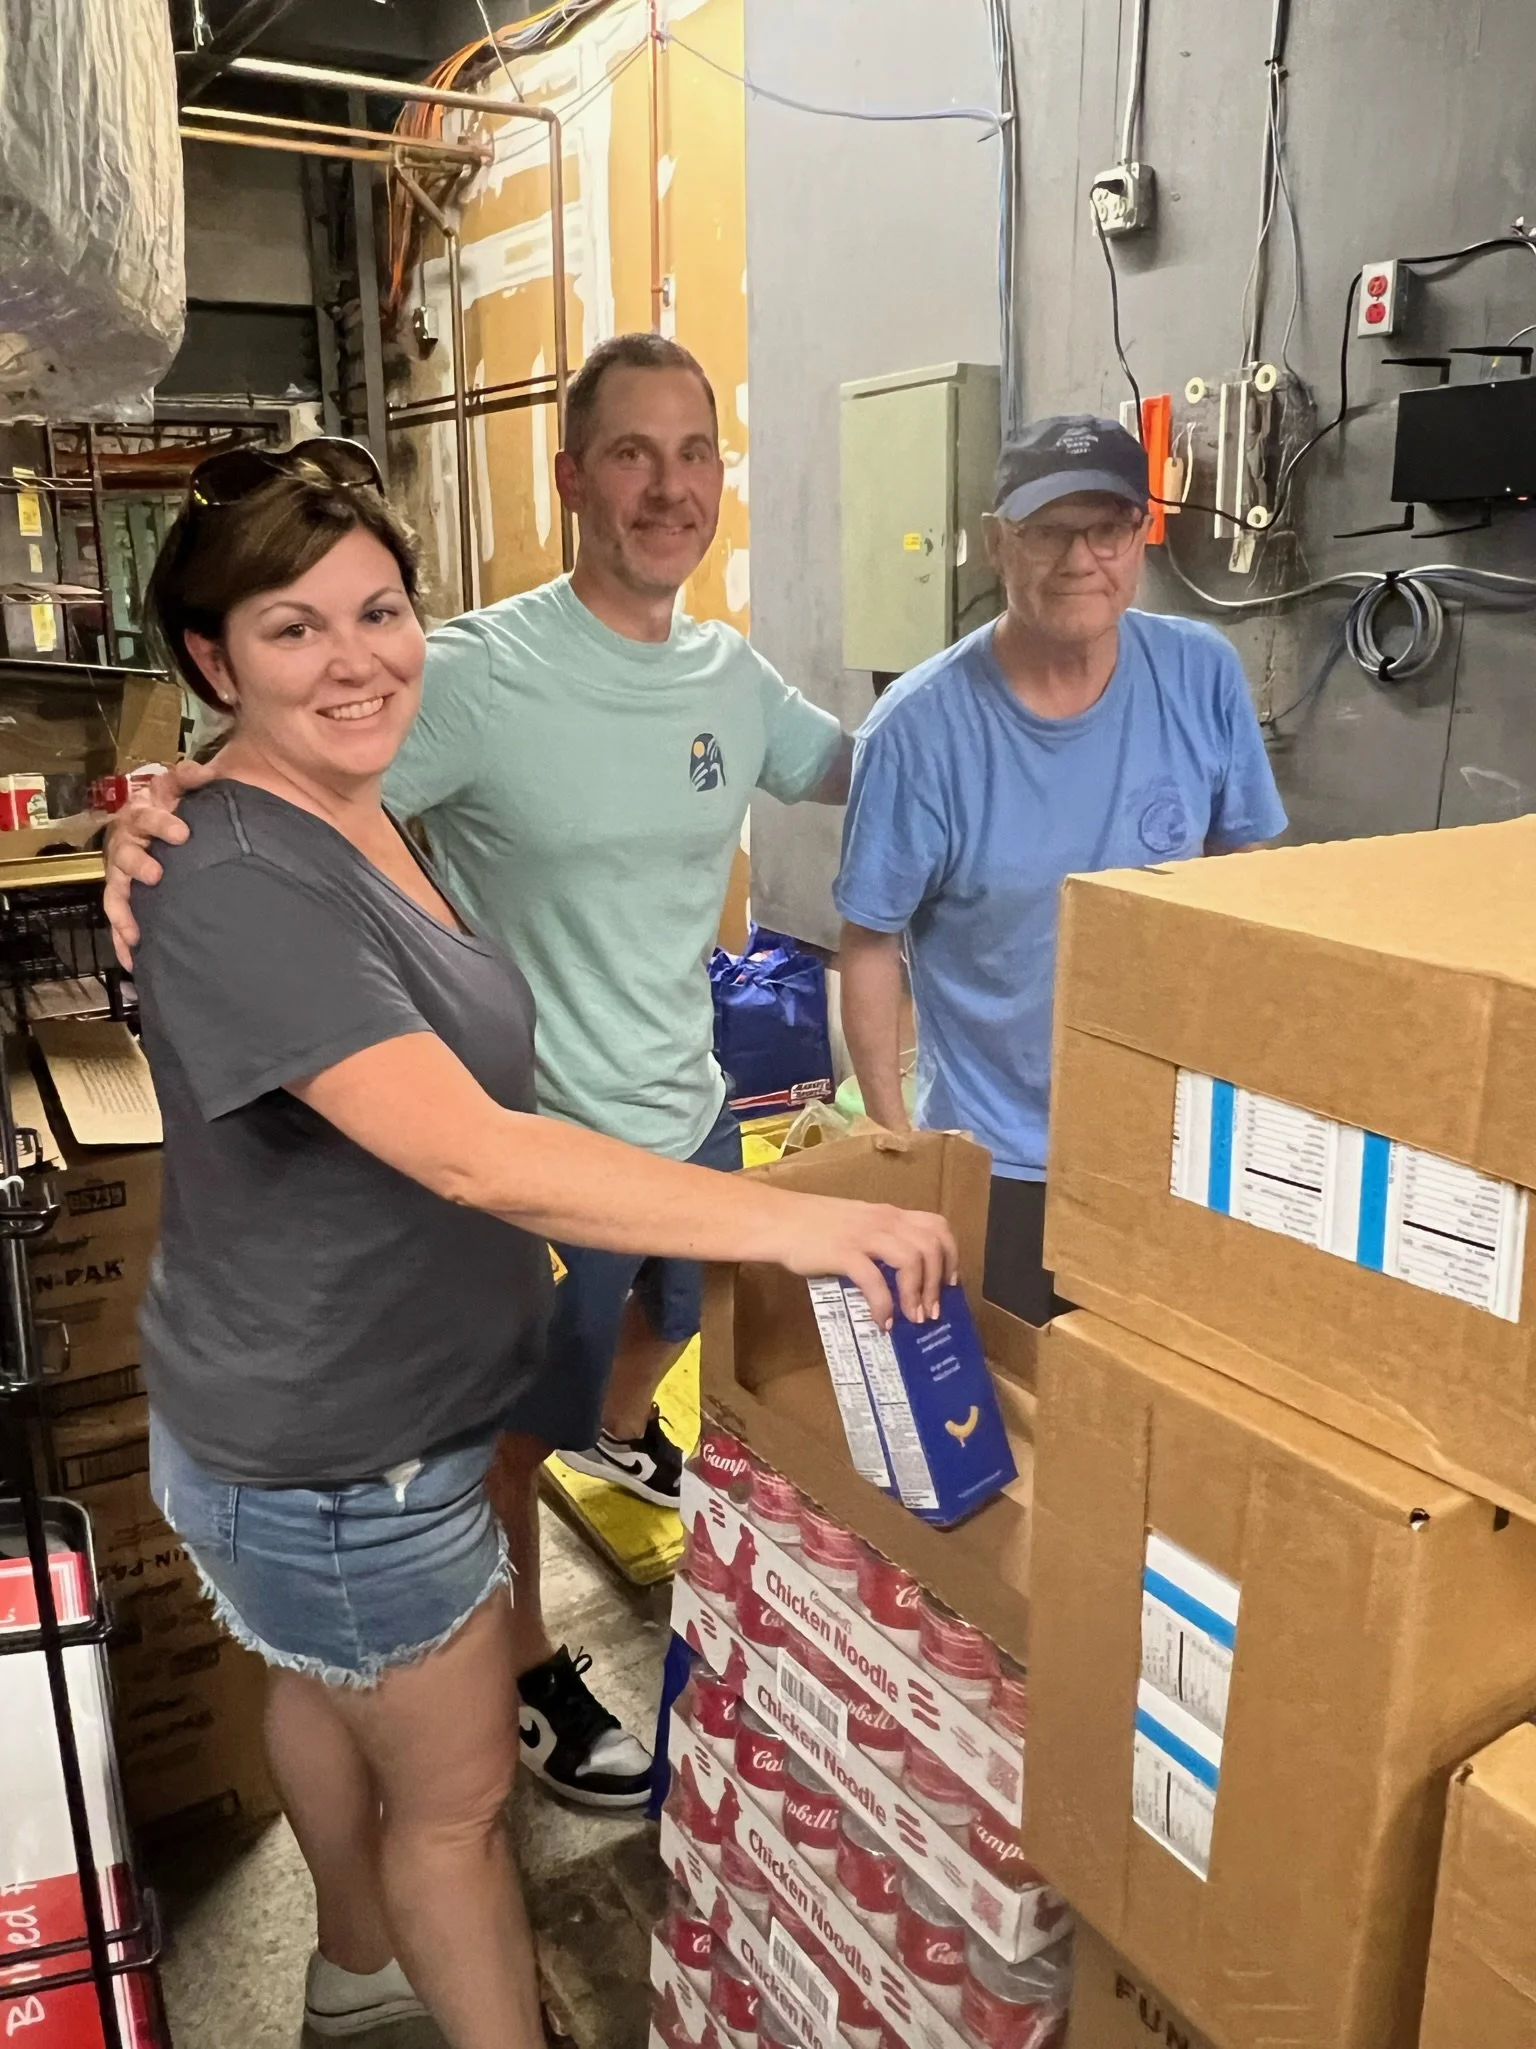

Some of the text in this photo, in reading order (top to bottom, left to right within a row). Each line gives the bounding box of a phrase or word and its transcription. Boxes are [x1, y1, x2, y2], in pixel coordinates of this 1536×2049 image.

[765, 1569, 831, 1645] Chicken
[834, 1625, 899, 1704] Noodle
[758, 1684, 887, 1827] Chicken Noodle
[749, 1828, 808, 1911] Chicken
[811, 1903, 873, 1986] Noodle
[740, 1938, 799, 2026] Chicken
